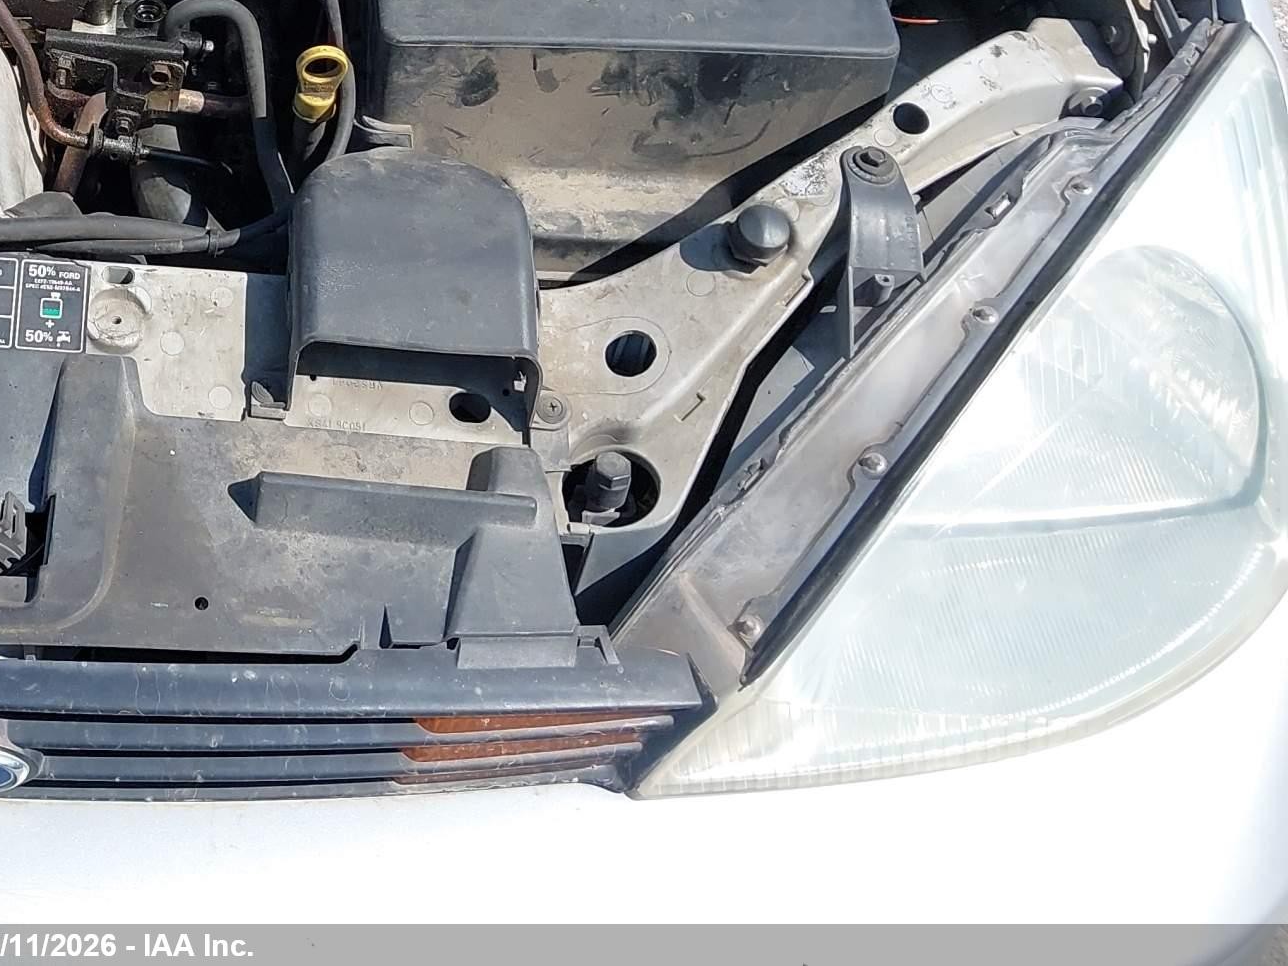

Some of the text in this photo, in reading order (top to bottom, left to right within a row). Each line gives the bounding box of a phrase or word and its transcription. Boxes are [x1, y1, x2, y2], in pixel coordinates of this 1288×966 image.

[28, 264, 81, 280] 50% FORD
[25, 330, 54, 343] 50%
